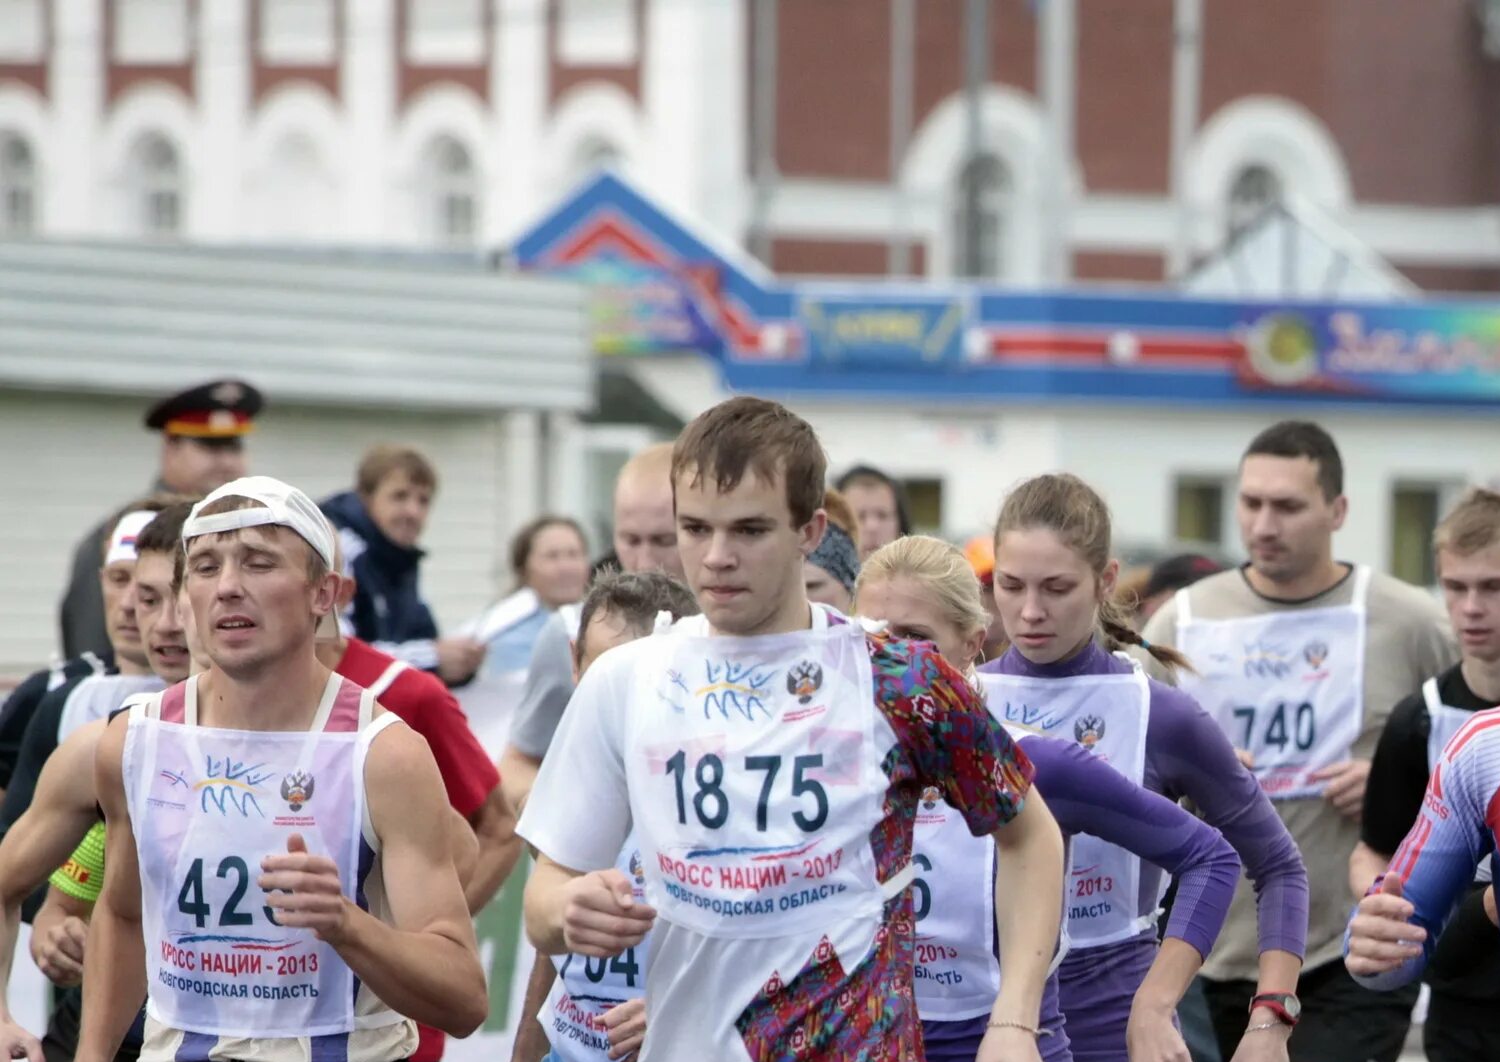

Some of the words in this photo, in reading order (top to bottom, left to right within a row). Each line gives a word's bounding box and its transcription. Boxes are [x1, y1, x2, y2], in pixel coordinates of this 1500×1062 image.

[1233, 702, 1315, 752] 740
[666, 750, 829, 832] 1875
[1424, 793, 1449, 820] das
[657, 852, 713, 888] КРОСС
[720, 866, 786, 892] НАЦИИ
[1076, 876, 1112, 896] 2013
[664, 881, 774, 916] НОВГОРОДСКАЯ
[779, 883, 847, 911] ОБЛАСТЬ
[1068, 901, 1112, 919] ЛАСТЬ
[161, 942, 195, 971] КРОСС
[201, 953, 262, 976] НАЦИИ
[277, 953, 318, 975] 2013
[159, 968, 248, 997] НОВГОРОДСКАЯ
[253, 984, 319, 999] ОБЛАСТЬ
